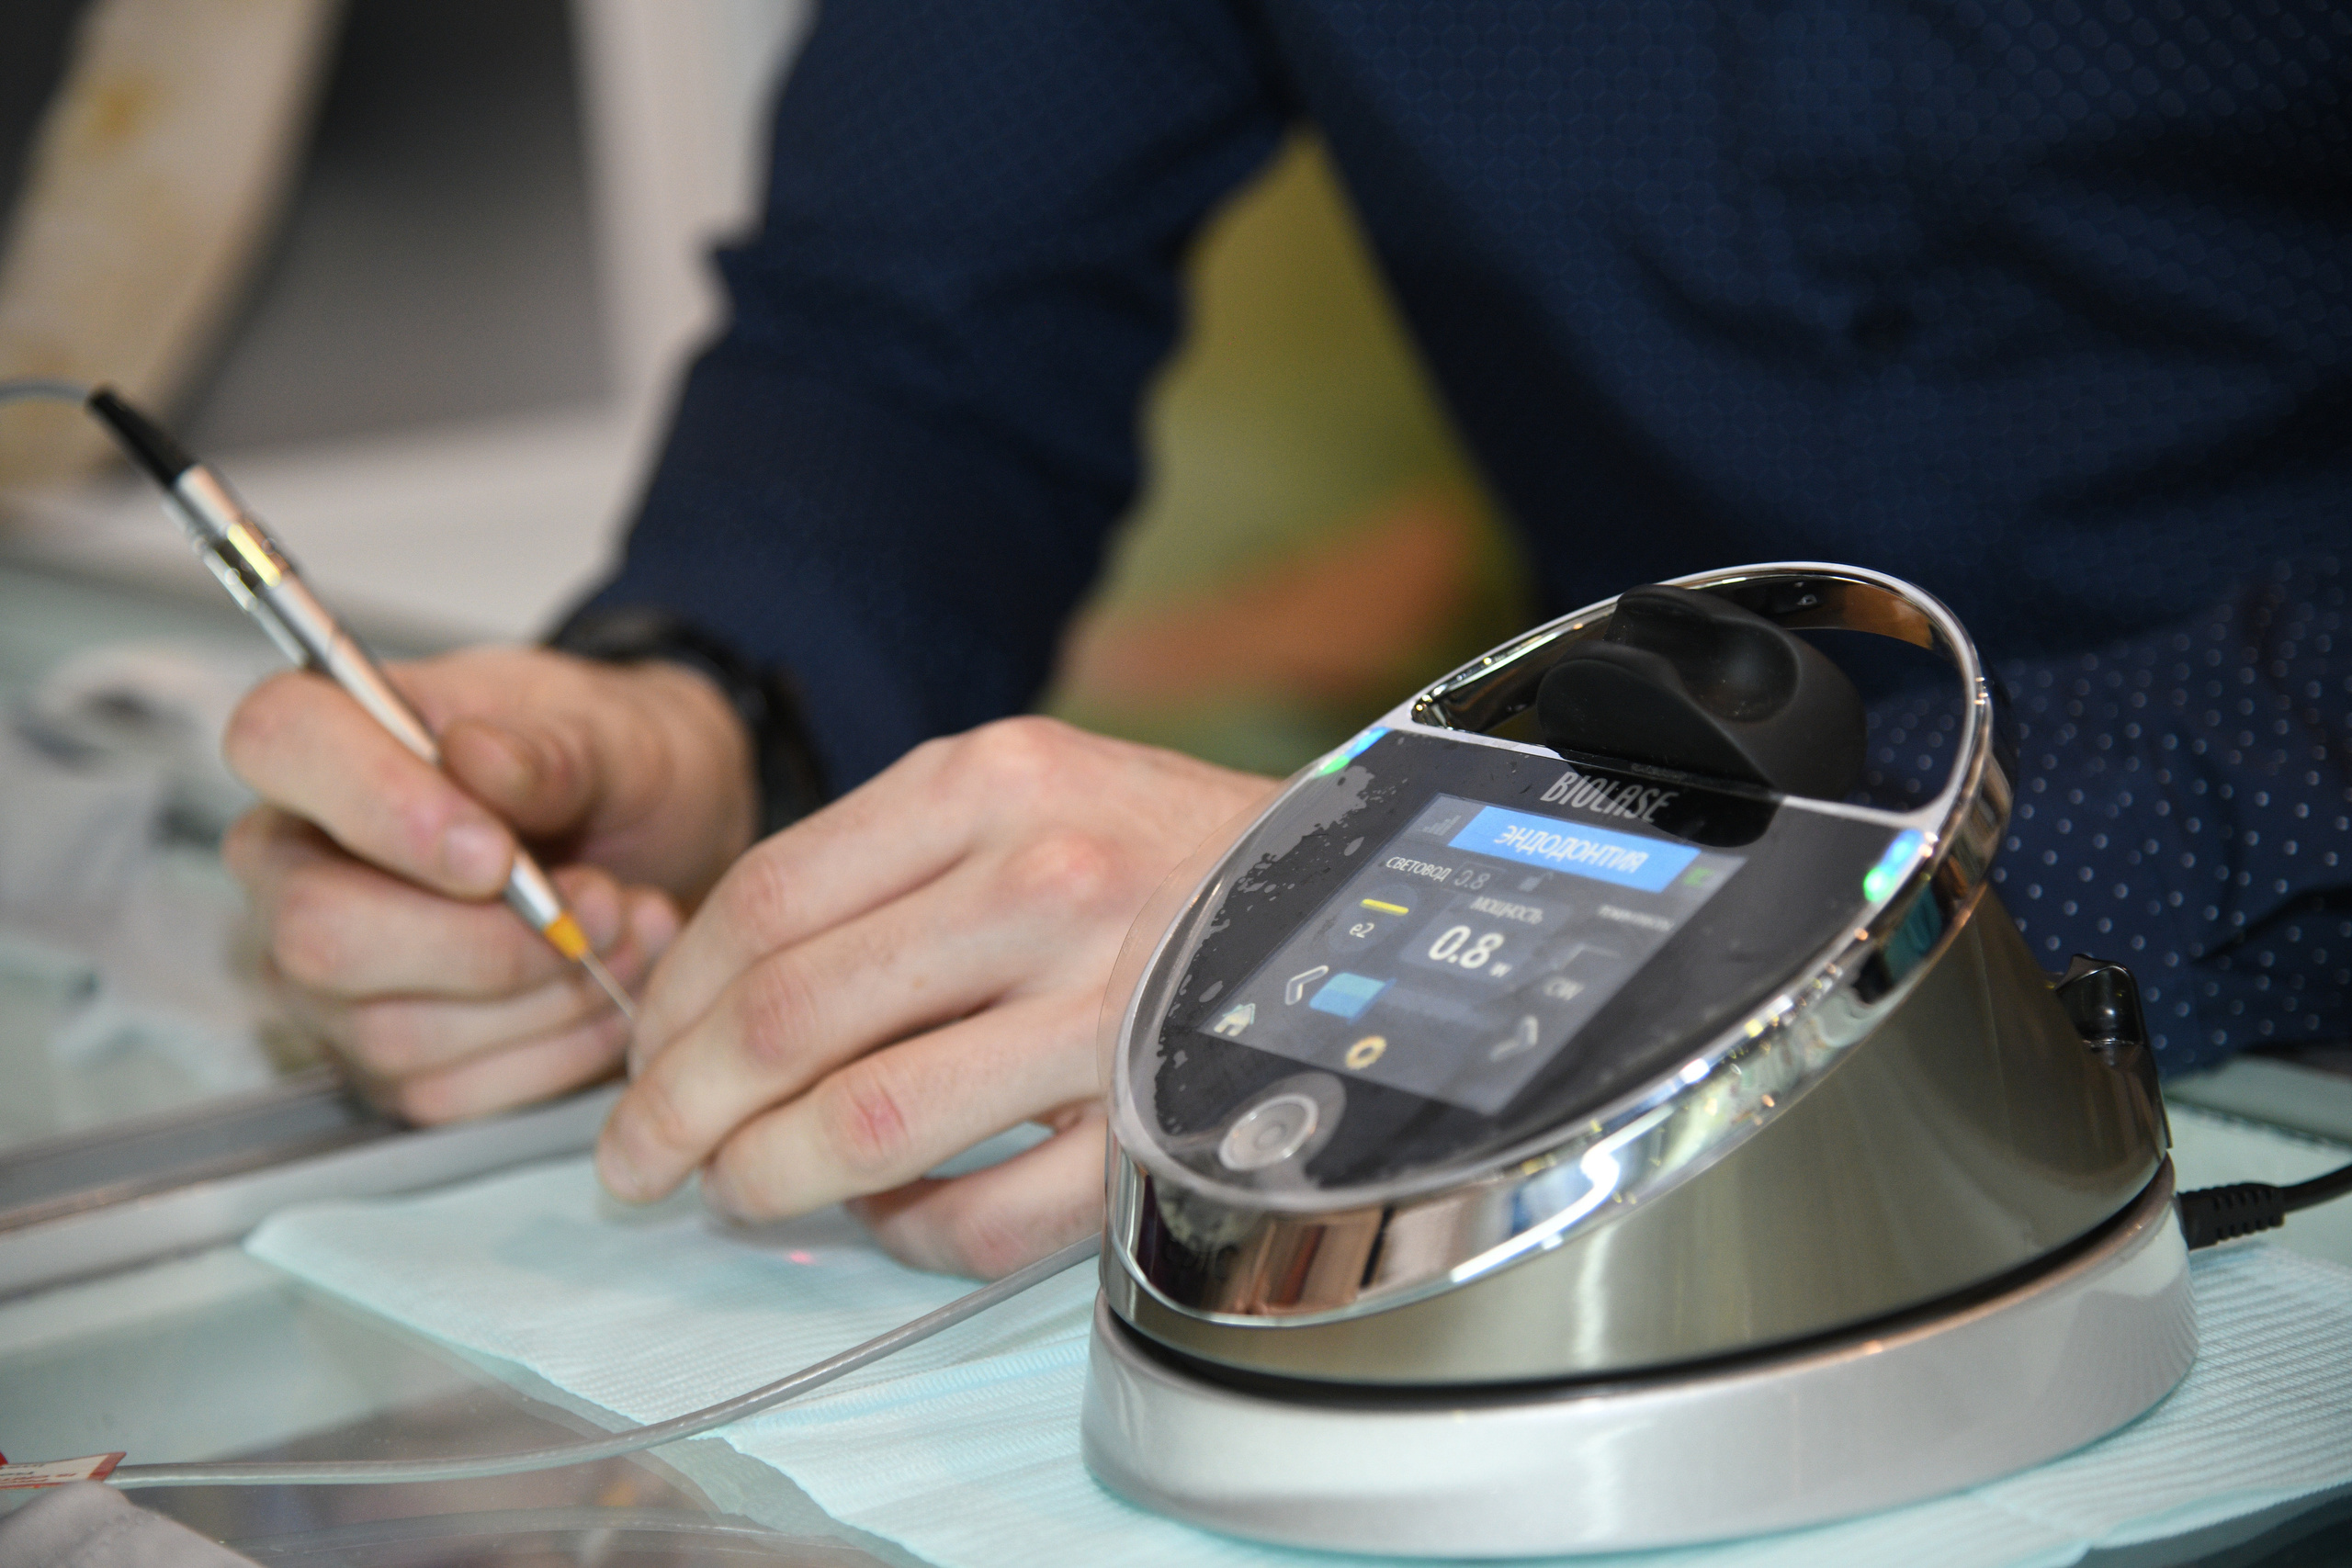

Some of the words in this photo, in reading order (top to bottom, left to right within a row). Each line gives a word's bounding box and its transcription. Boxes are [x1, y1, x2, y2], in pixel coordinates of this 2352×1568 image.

[1540, 771, 1679, 822] BIOLASE
[1385, 856, 1453, 883] СВЕТОВОД
[1494, 825, 1650, 874] ЭНДОДОНТИЯ
[1349, 922, 1374, 938] e2
[1429, 924, 1505, 969] 0.8
